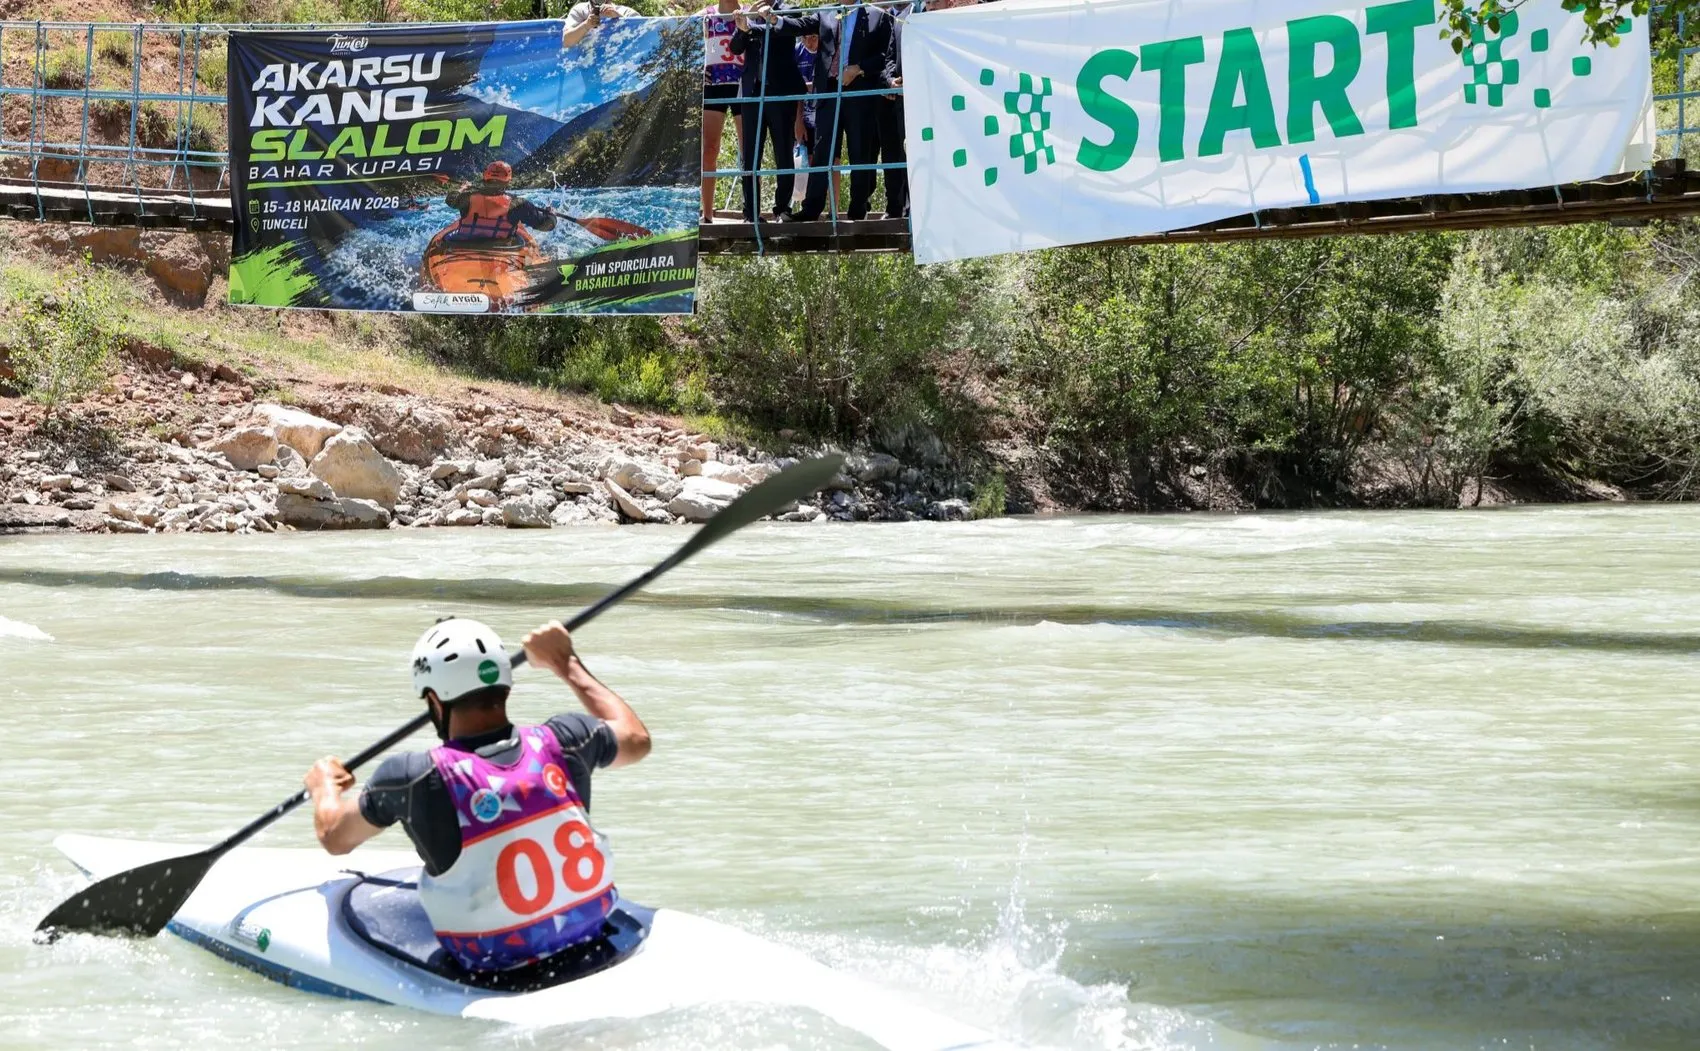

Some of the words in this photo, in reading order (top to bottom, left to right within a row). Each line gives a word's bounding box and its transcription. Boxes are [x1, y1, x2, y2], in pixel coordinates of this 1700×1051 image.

[719, 33, 744, 67] 3
[252, 51, 446, 92] AKARSU
[1076, 0, 1436, 172] START
[250, 86, 429, 127] KANO
[248, 115, 508, 162] SLALOM
[249, 164, 335, 180] BAHAR
[347, 157, 442, 176] KUPASI
[263, 200, 301, 213] 15-18
[304, 196, 362, 212] HAZİRAN
[365, 196, 399, 210] 2026
[262, 216, 308, 230] TUNCELİ
[575, 274, 630, 292] BAŞARILAR
[633, 267, 695, 285] DİLİYORUM
[585, 261, 606, 276] TÜM
[608, 255, 675, 273] SPORCULARA
[452, 295, 483, 303] AYGÖL
[496, 820, 605, 915] 08
